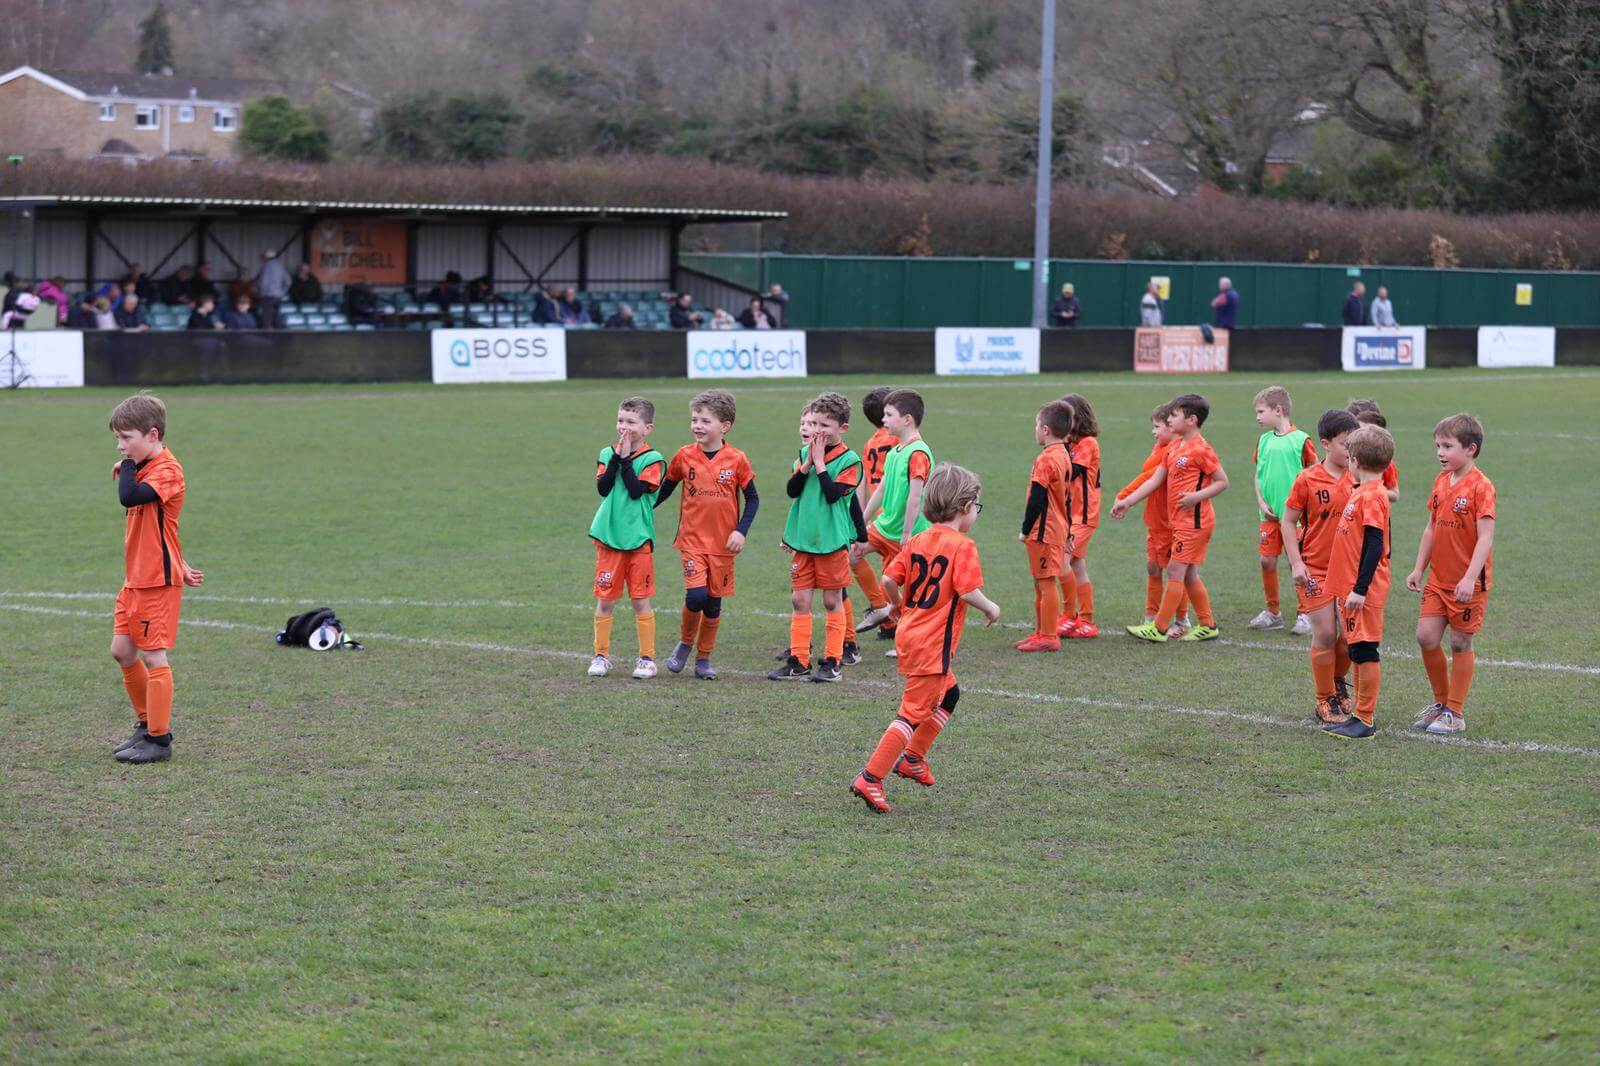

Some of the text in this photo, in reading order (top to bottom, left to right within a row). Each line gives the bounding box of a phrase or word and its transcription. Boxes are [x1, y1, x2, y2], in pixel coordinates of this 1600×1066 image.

[319, 252, 396, 269] MITCHELL
[473, 338, 548, 359] BOSS
[689, 467, 695, 480] 6
[1315, 489, 1330, 505] 19
[1176, 541, 1183, 553] 3
[1040, 557, 1047, 569] 2
[905, 552, 949, 610] 28
[1462, 608, 1471, 622] 8
[141, 620, 150, 637] 7
[1346, 617, 1356, 633] 16
